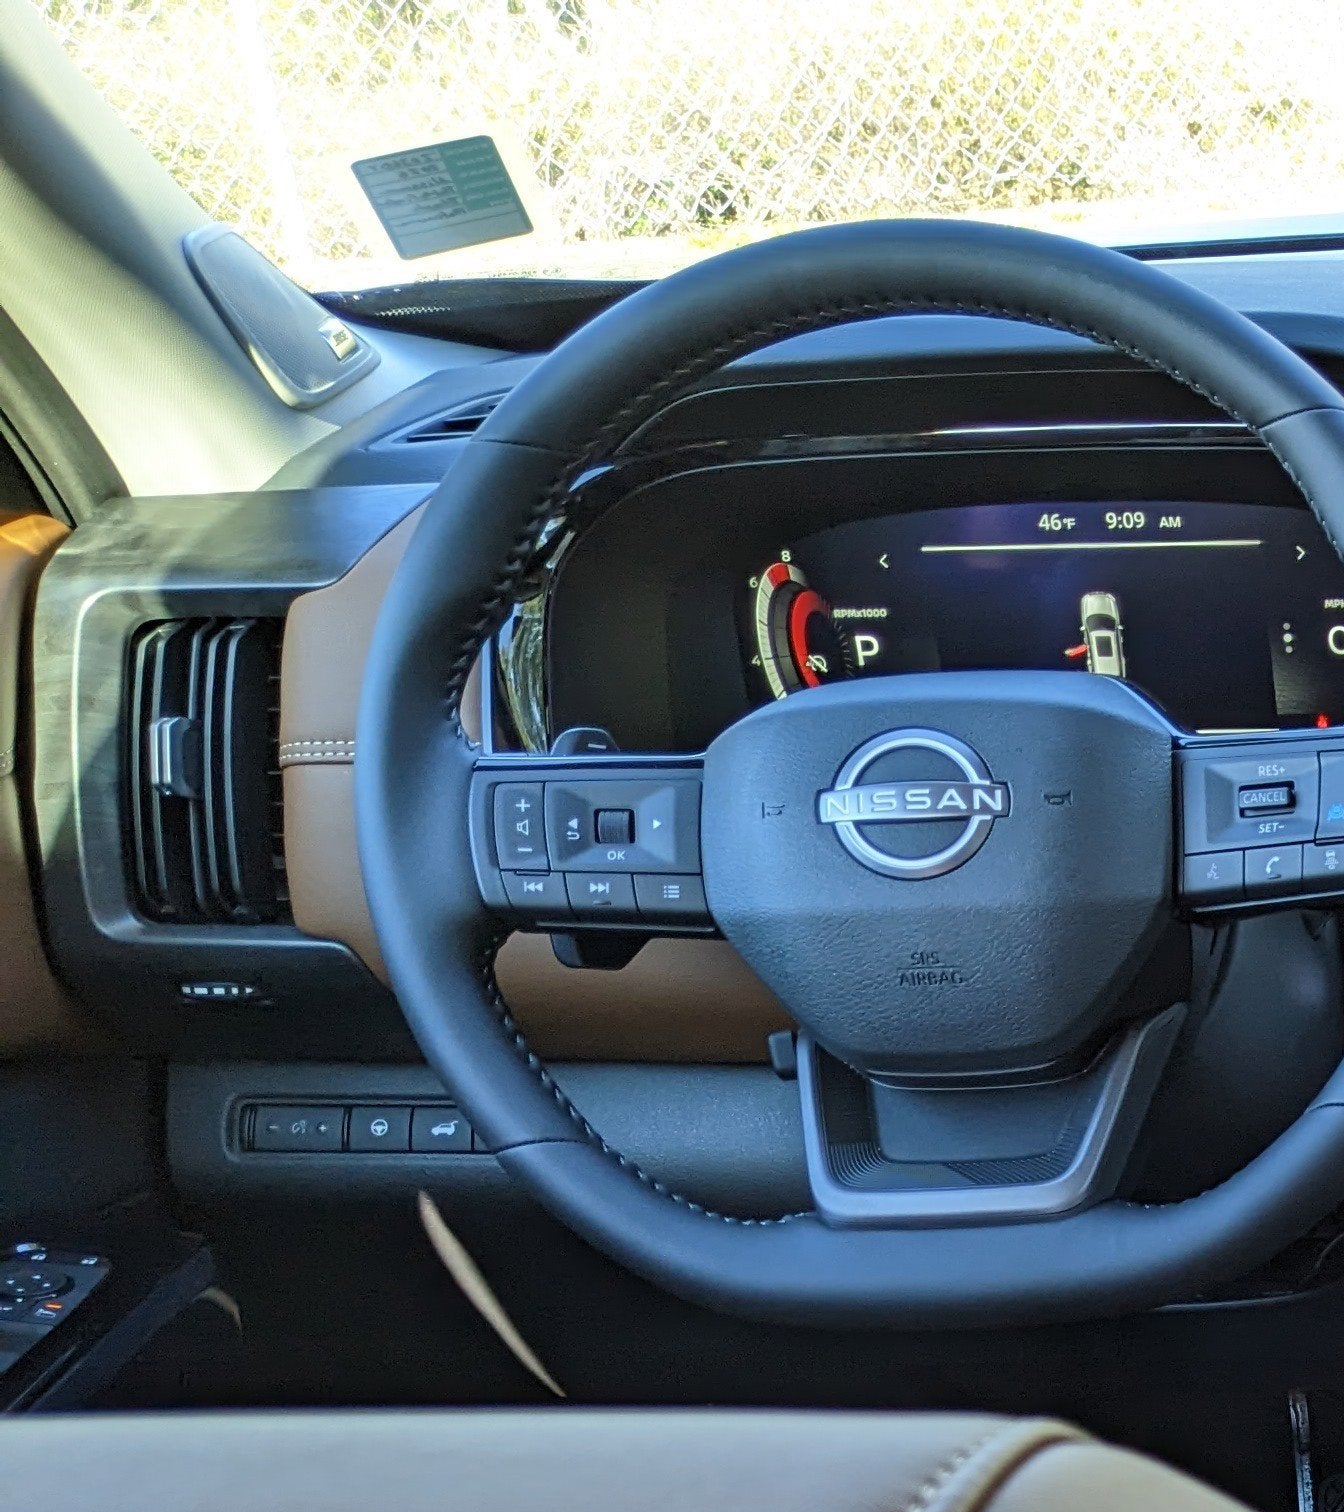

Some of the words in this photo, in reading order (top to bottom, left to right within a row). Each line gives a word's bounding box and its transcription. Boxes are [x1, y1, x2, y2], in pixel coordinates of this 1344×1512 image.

[1105, 512, 1145, 529] 9:09
[1159, 516, 1182, 528] AM
[782, 551, 790, 562] 8
[750, 577, 758, 587] 6
[855, 635, 879, 666] P
[751, 655, 760, 666] 4
[1258, 765, 1286, 776] RES+
[825, 788, 1002, 816] NISSAN
[1243, 792, 1286, 804] CANCEL
[1258, 823, 1285, 834] SET-
[607, 851, 625, 861] OK
[899, 971, 964, 986] AIRBAG
